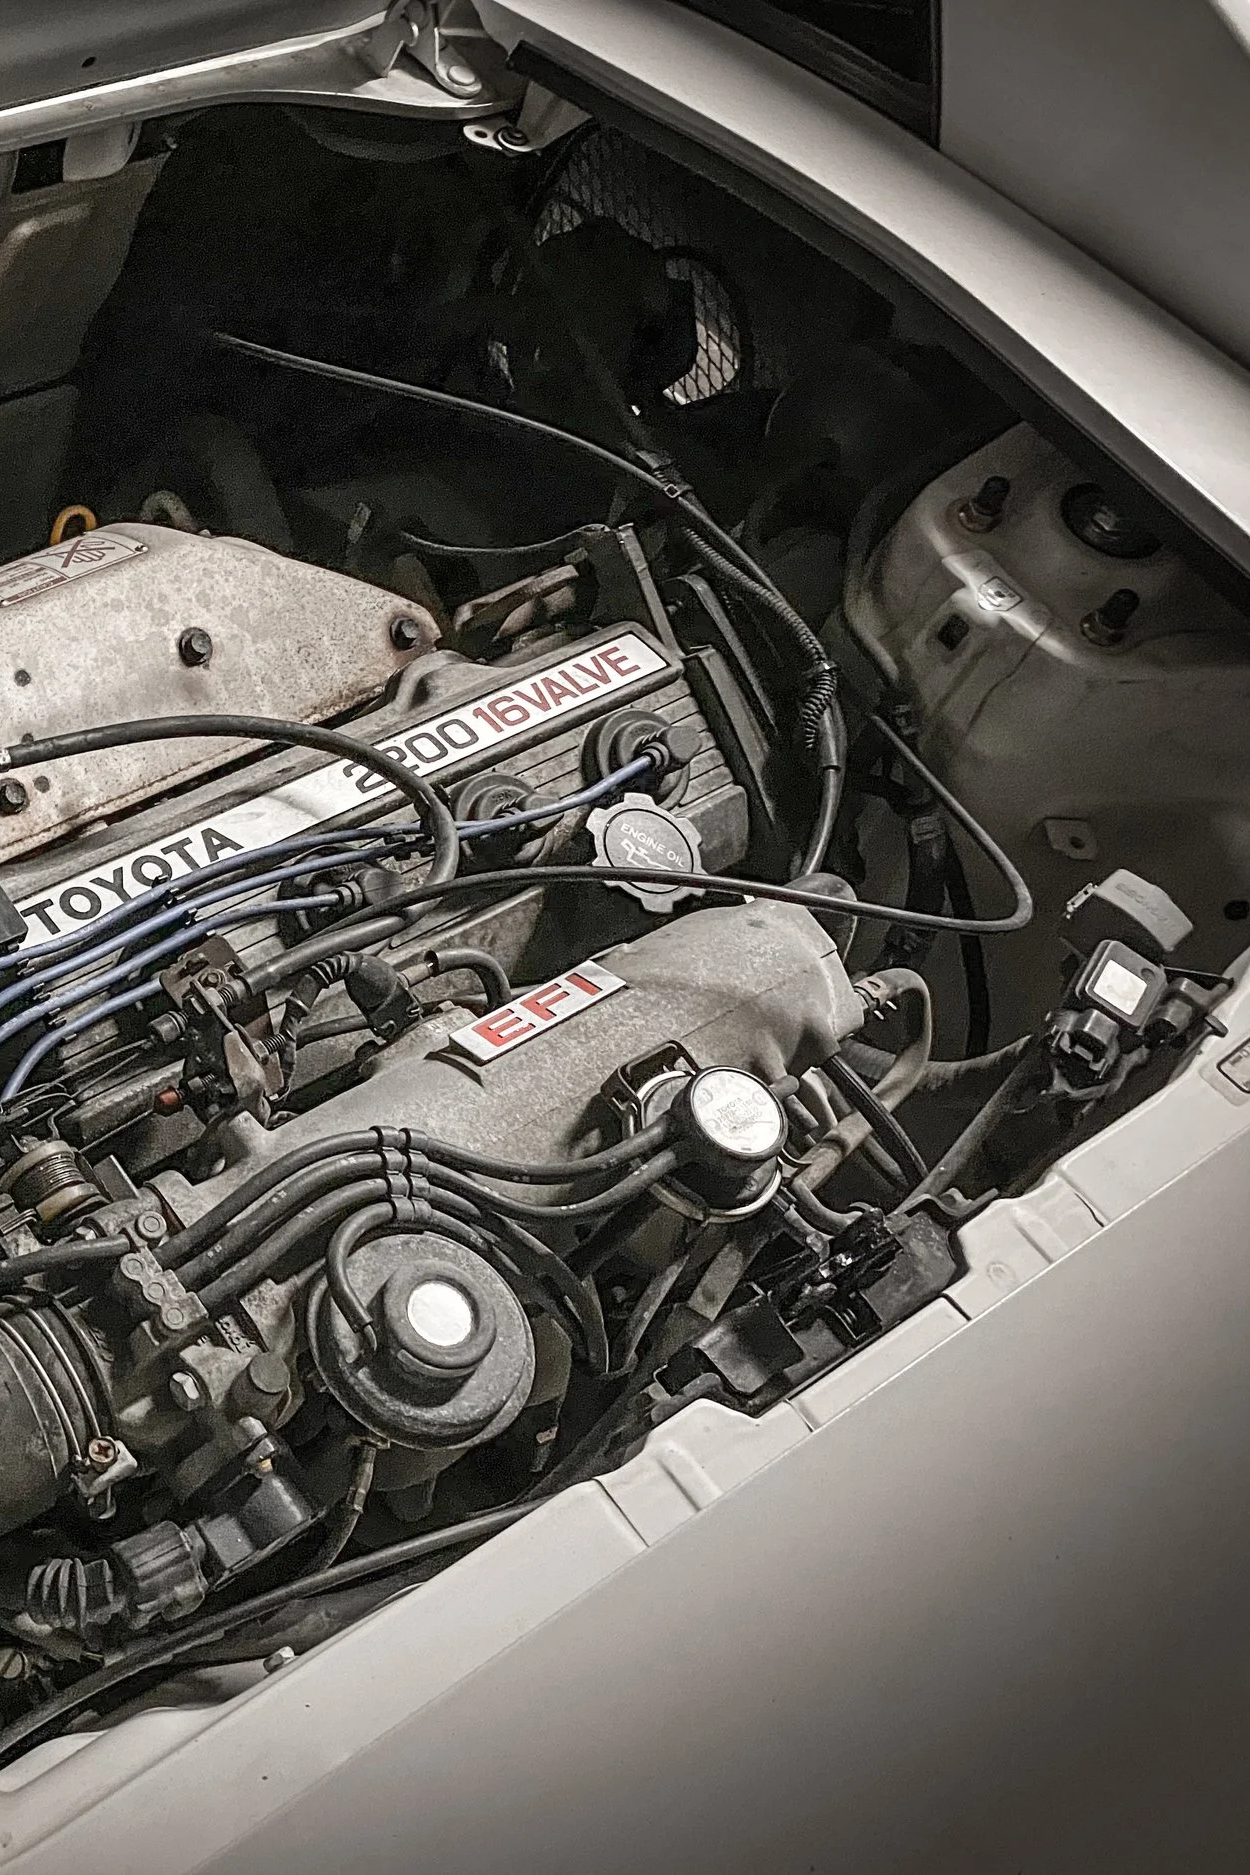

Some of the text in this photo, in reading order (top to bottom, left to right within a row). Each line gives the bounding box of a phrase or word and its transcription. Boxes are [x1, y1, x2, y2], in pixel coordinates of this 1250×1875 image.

[472, 646, 641, 733] 16VALVE
[20, 827, 244, 935] TOYOTA
[620, 823, 684, 868] ENGINE OIL
[471, 972, 603, 1047] EFI
